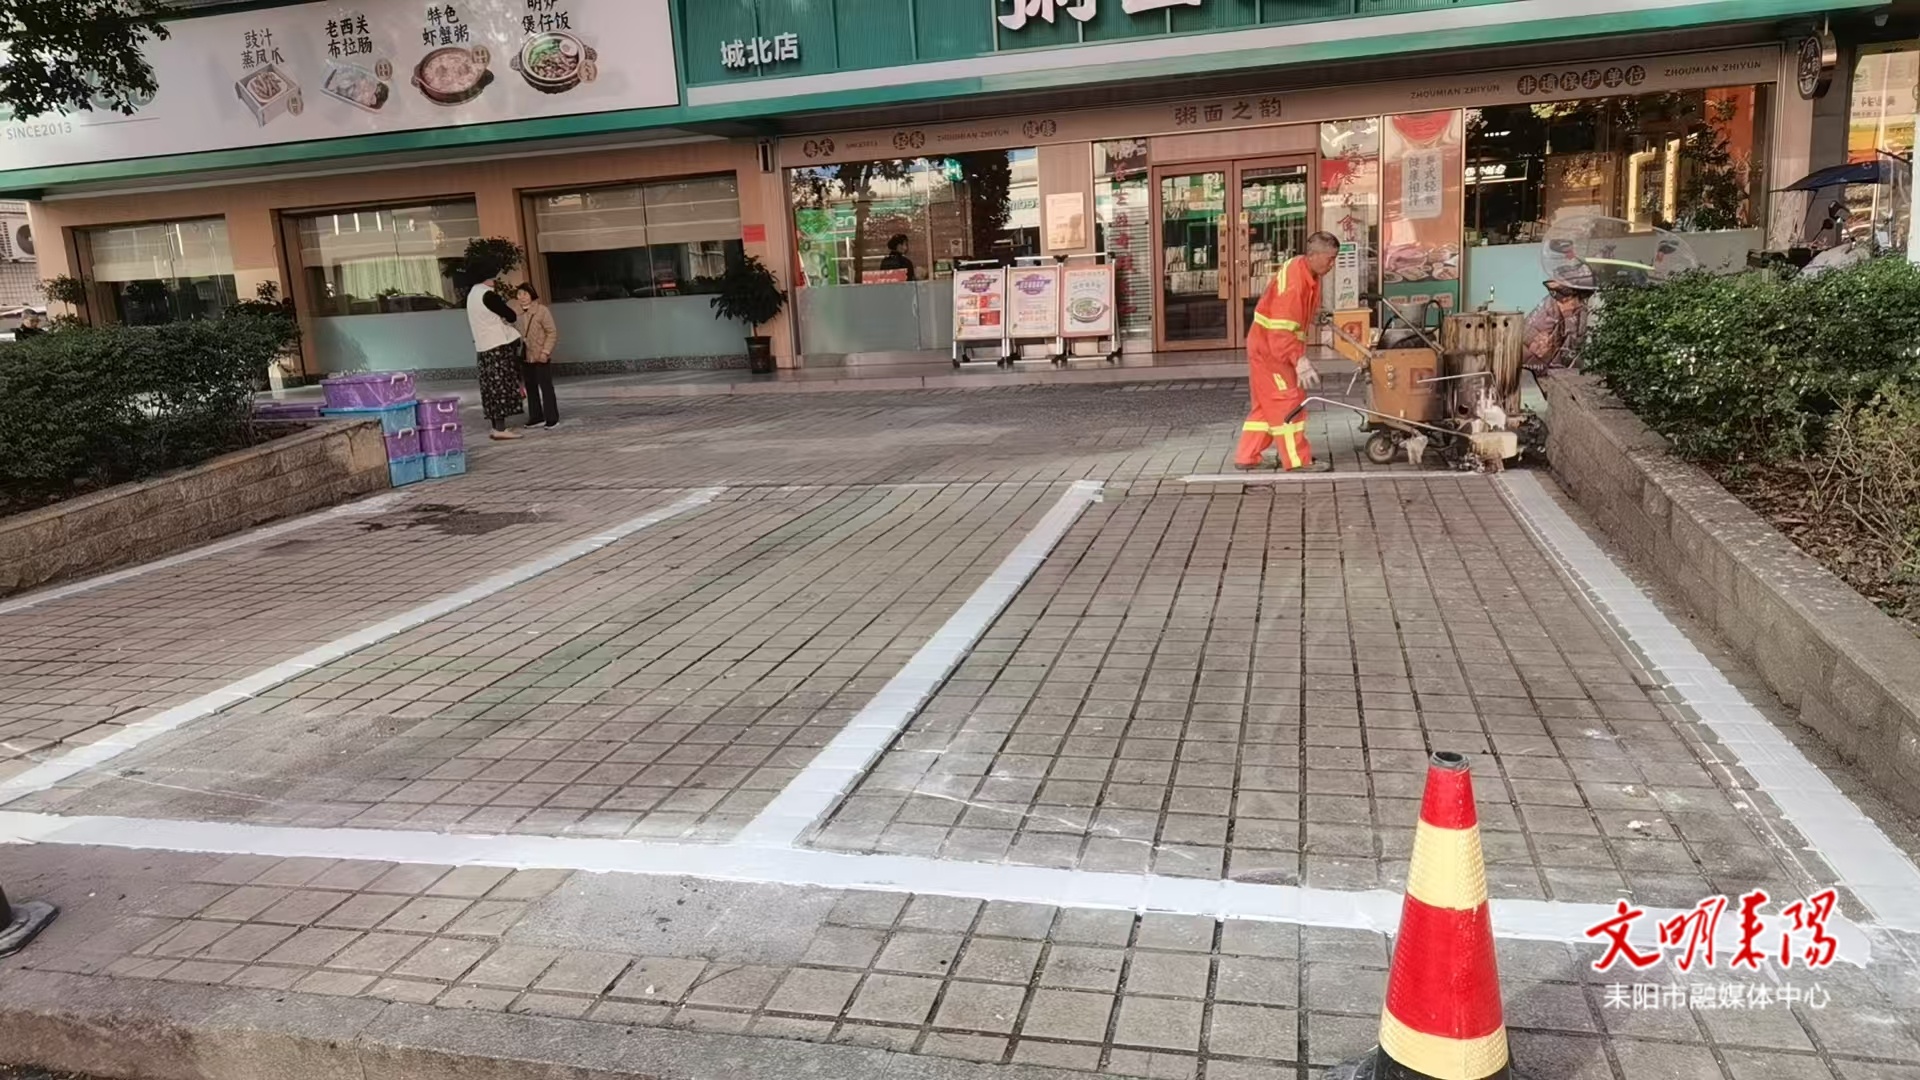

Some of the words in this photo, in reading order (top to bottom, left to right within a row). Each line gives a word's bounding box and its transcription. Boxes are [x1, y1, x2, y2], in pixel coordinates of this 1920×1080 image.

[325, 14, 370, 38] 老西关
[427, 4, 459, 26] 特色
[522, 11, 572, 34] 煲仔饭
[244, 28, 273, 48] 豉汁
[423, 24, 470, 46] 虾蟹粥
[241, 47, 285, 69] 蒸凤爪
[327, 36, 373, 58] 布拉肠
[720, 31, 799, 68] 城北店
[1517, 64, 1647, 95] 非遗保护单位
[1664, 64, 1719, 77] ZHOUMIAN
[1723, 60, 1761, 73] ZHIYUN
[1410, 87, 1461, 99] ZHOUMIAN
[1464, 83, 1500, 94] ZHIYUN
[1174, 96, 1282, 126] 粥面之韵
[7, 122, 72, 140] SINCE2013
